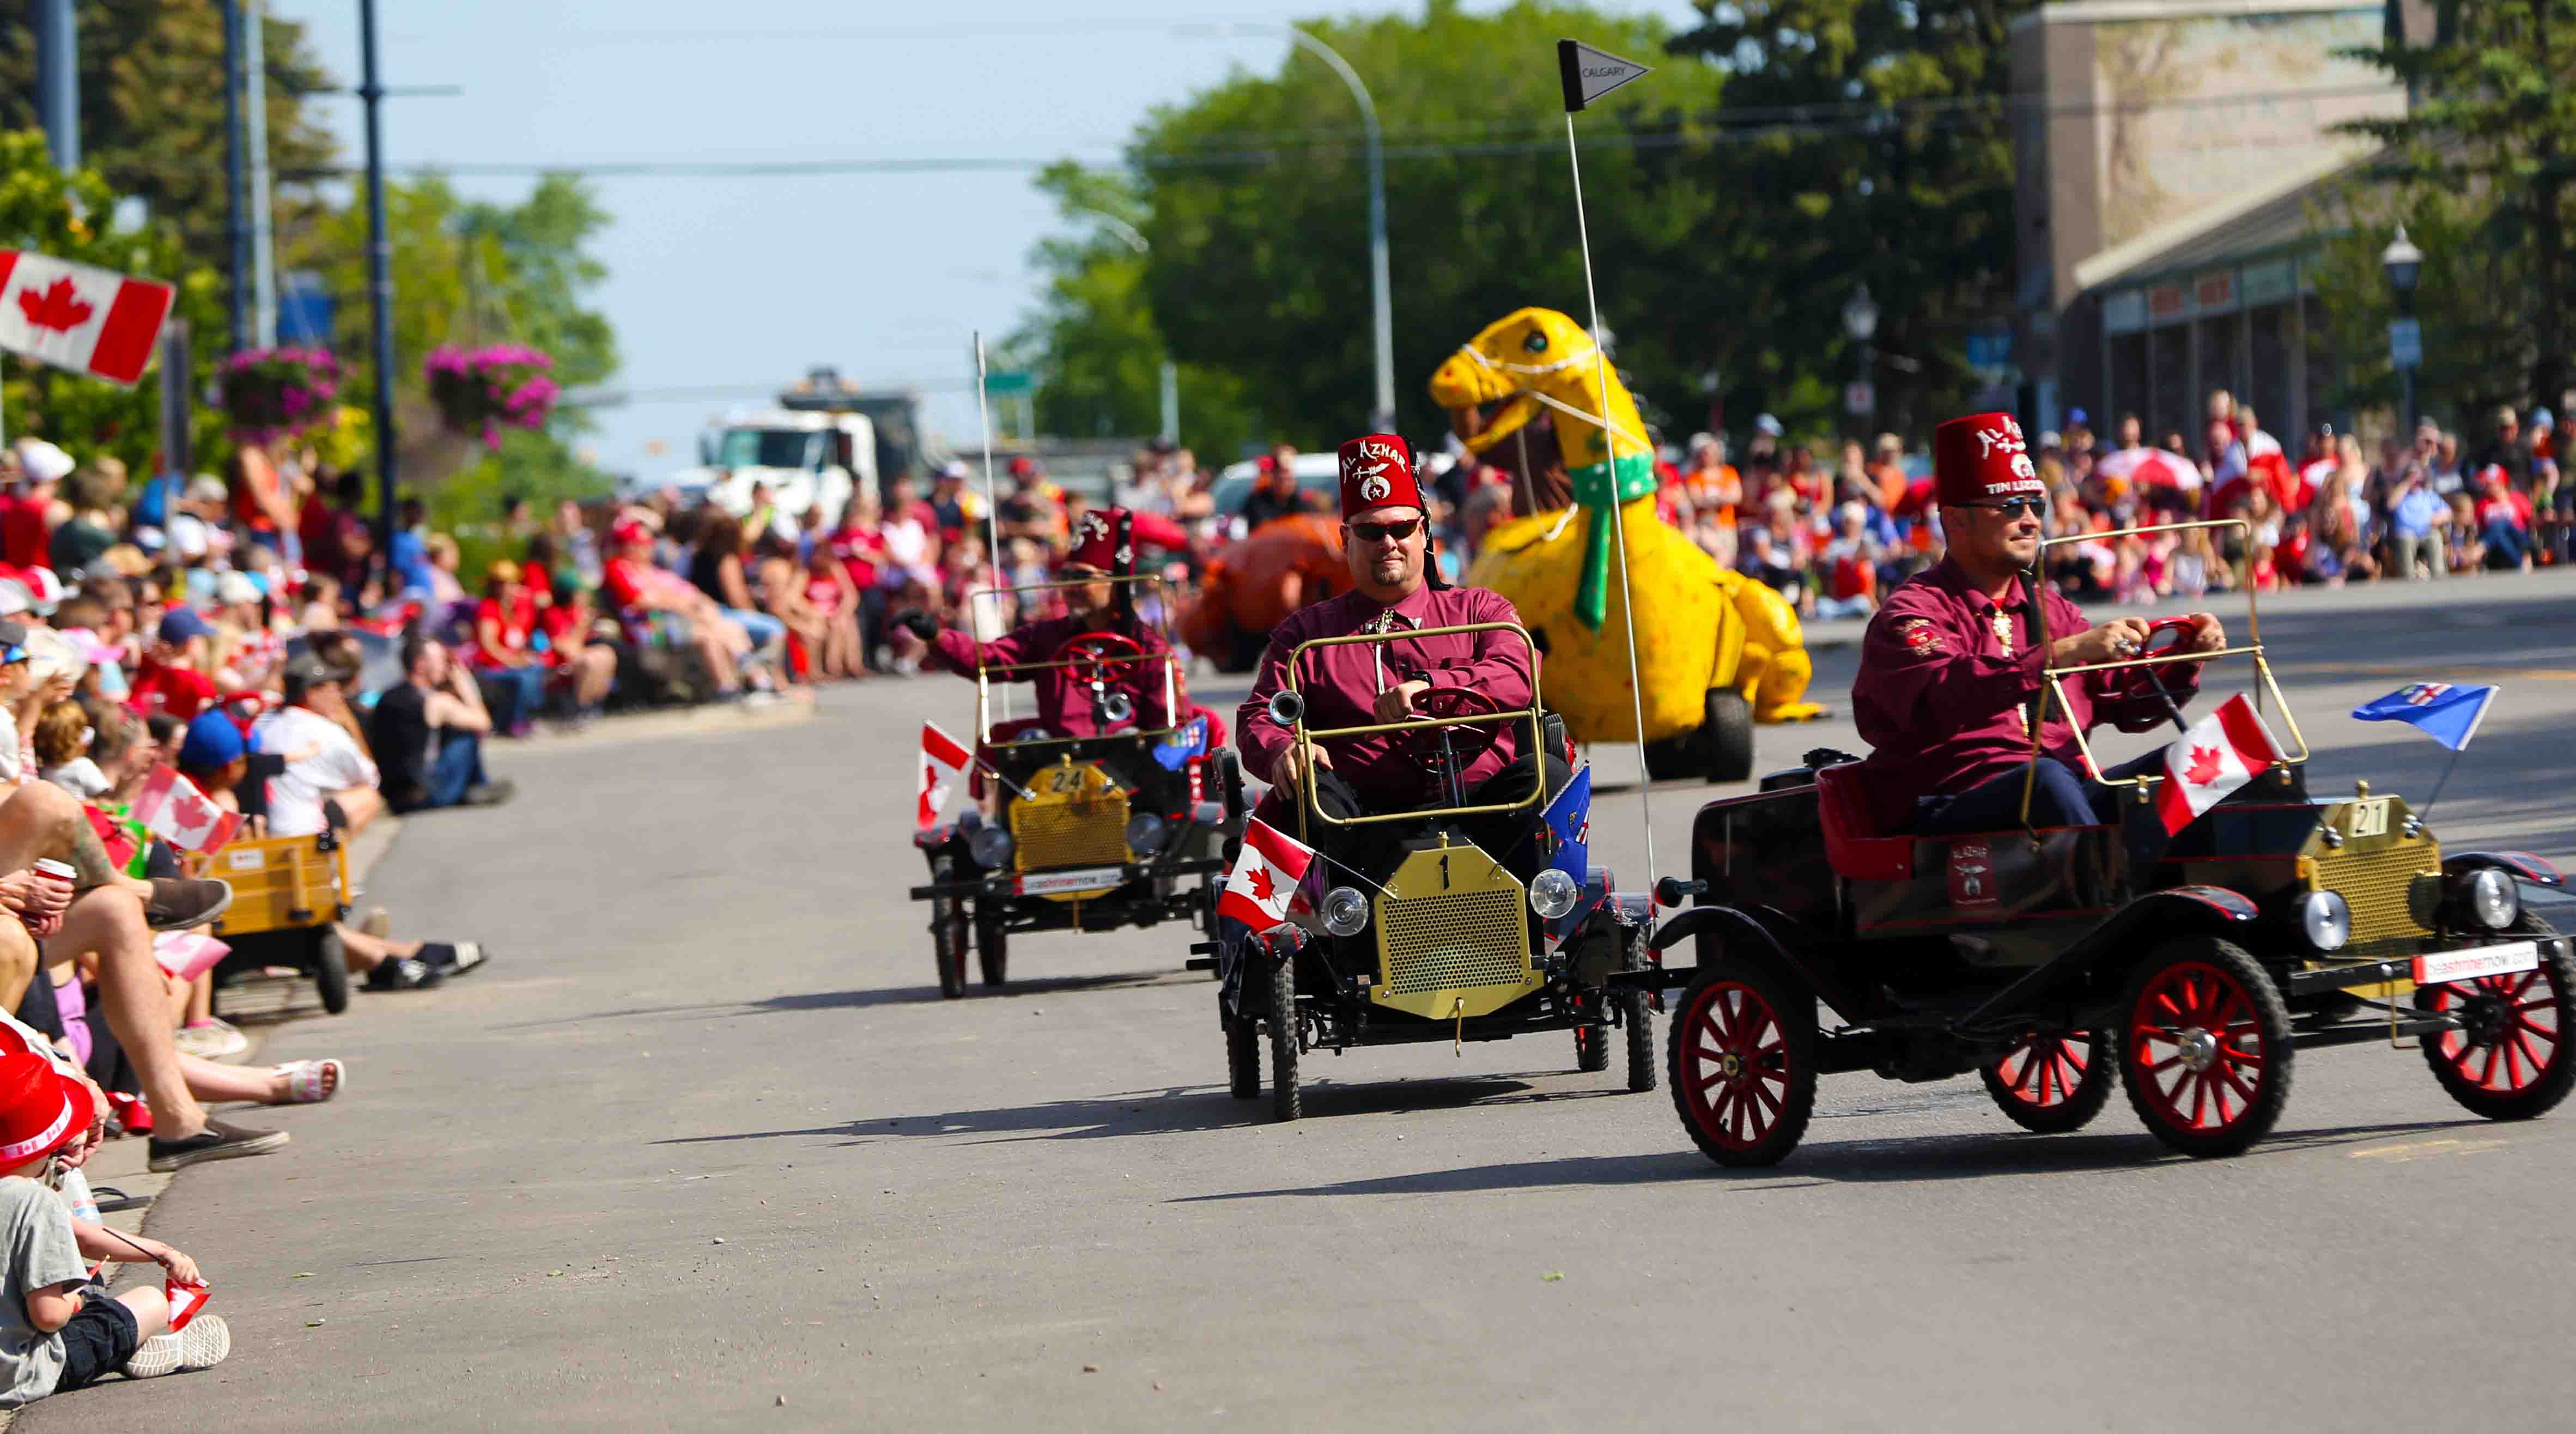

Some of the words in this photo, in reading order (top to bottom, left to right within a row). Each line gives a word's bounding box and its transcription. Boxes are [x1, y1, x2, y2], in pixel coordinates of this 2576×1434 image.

[1582, 66, 1626, 78] CALGARY
[1359, 440, 1407, 474] AZHAR
[1985, 482, 2011, 494] TIN
[1052, 771, 1082, 792] 24
[2354, 803, 2382, 833] 21
[1438, 854, 1450, 890] 1
